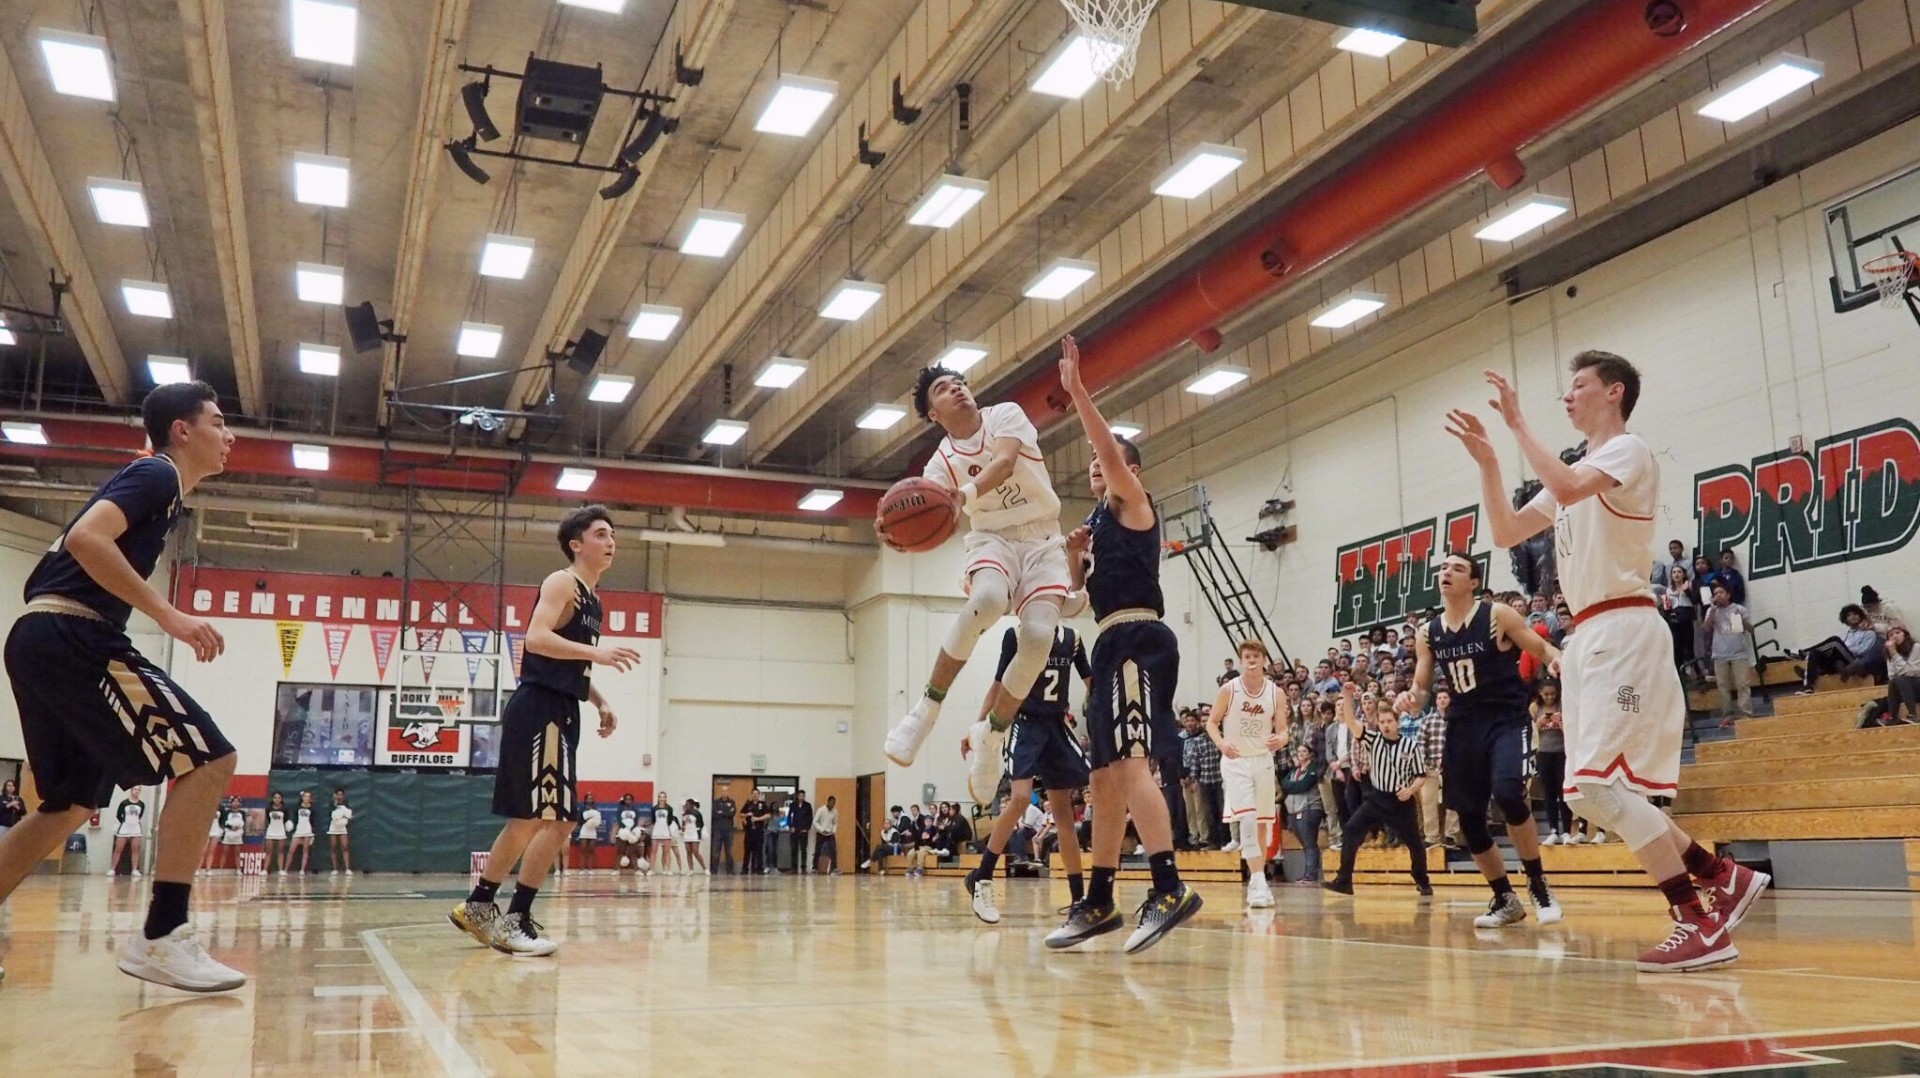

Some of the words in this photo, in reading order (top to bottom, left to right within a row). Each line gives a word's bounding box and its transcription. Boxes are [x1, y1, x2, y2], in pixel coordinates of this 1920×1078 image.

[1332, 503, 1491, 638] HILL
[193, 588, 475, 625] CENTENNIAL
[505, 604, 650, 633] LUE
[279, 628, 301, 668] WARRIORS
[1434, 642, 1485, 660] MULLEN
[1043, 669, 1060, 702] 2
[1447, 658, 1478, 694] 10
[1240, 718, 1263, 739] 22
[391, 754, 454, 764] BUFFALOES
